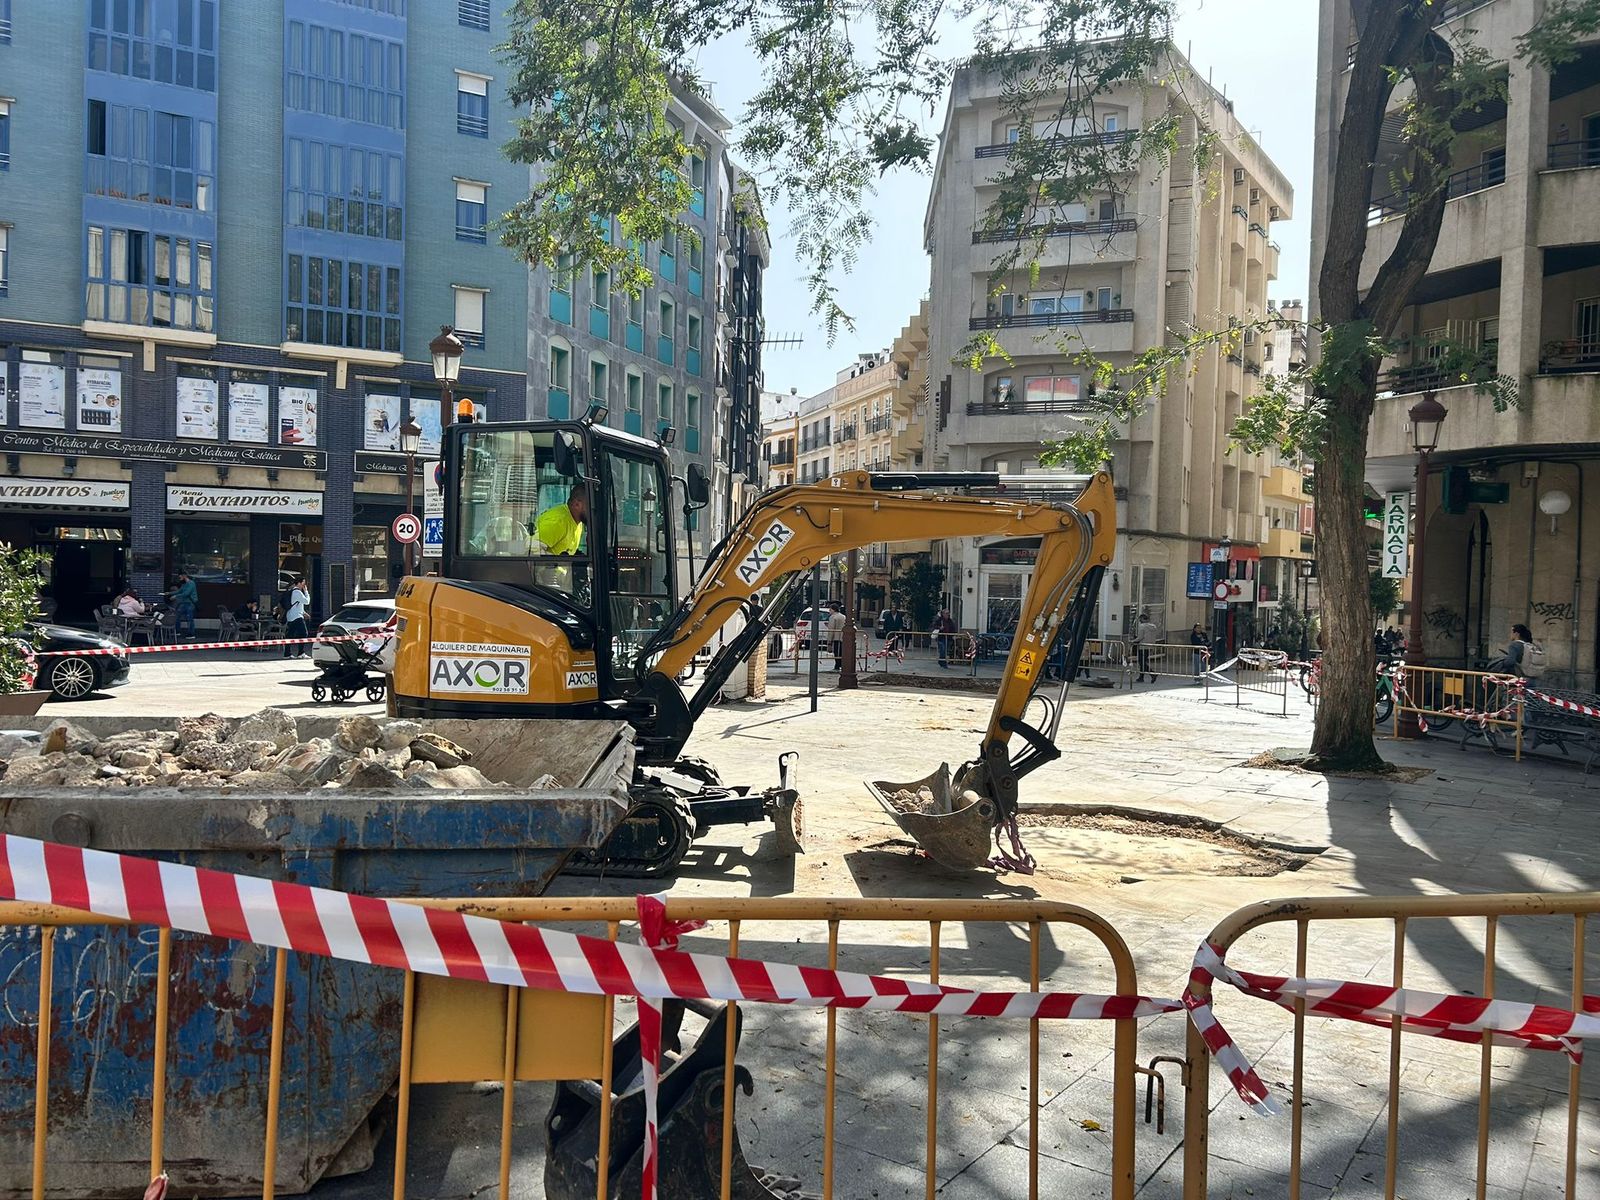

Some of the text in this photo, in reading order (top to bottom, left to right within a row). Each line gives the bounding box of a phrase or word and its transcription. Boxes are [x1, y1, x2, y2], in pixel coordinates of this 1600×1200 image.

[3, 433, 39, 446] Centro
[42, 435, 87, 449] Médico
[89, 439, 102, 449] de
[104, 440, 177, 454] Especialidades
[178, 447, 187, 458] y
[189, 446, 239, 458] Medicina
[241, 448, 281, 461] Estética
[179, 495, 290, 507] MONTADITOS
[398, 523, 413, 534] 20
[1386, 494, 1405, 575] FARMACIA
[739, 523, 790, 583] AXOR
[431, 643, 530, 654] ALQUILER DE MAQUINARIA
[432, 659, 526, 688] AXOR
[568, 672, 597, 686] AXOR
